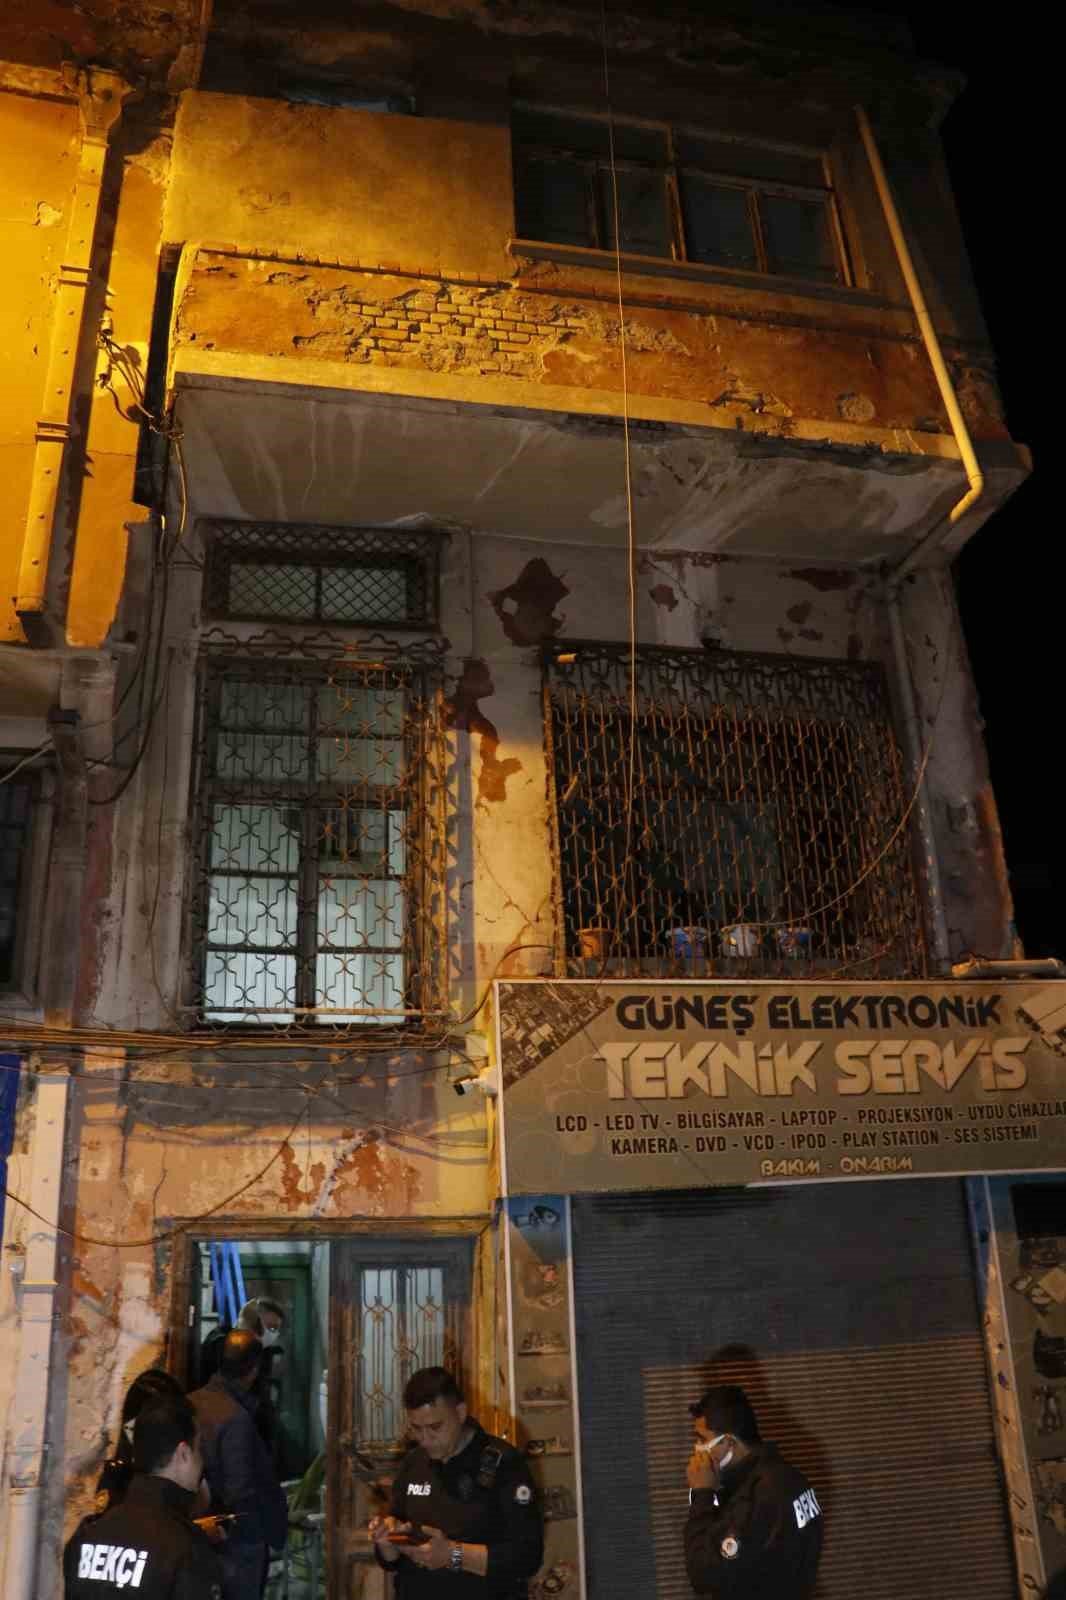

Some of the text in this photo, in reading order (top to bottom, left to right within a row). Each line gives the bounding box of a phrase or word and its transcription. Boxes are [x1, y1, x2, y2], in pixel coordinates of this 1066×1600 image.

[616, 994, 1001, 1036] GÜNEŞ ELEKTRONİK
[592, 1037, 1033, 1101] TEKNİK SERVİS
[556, 1115, 587, 1132] LCD
[606, 1114, 634, 1131] LED
[641, 1113, 660, 1130] TV
[677, 1109, 765, 1130] BİLGİSAYAR
[781, 1109, 837, 1127] LAPTOP
[968, 1104, 1005, 1121] UYDU
[611, 1138, 679, 1155] KAMERA
[695, 1136, 727, 1153] DVD
[743, 1135, 774, 1151] VCD
[791, 1133, 826, 1150] IPOD
[842, 1132, 878, 1148] PLAY
[882, 1128, 939, 1147] STATION
[953, 1127, 979, 1144] SES
[760, 1158, 821, 1177] BAKIM
[839, 1154, 913, 1174] ONARIM
[78, 1543, 149, 1589] BEKÇİ
